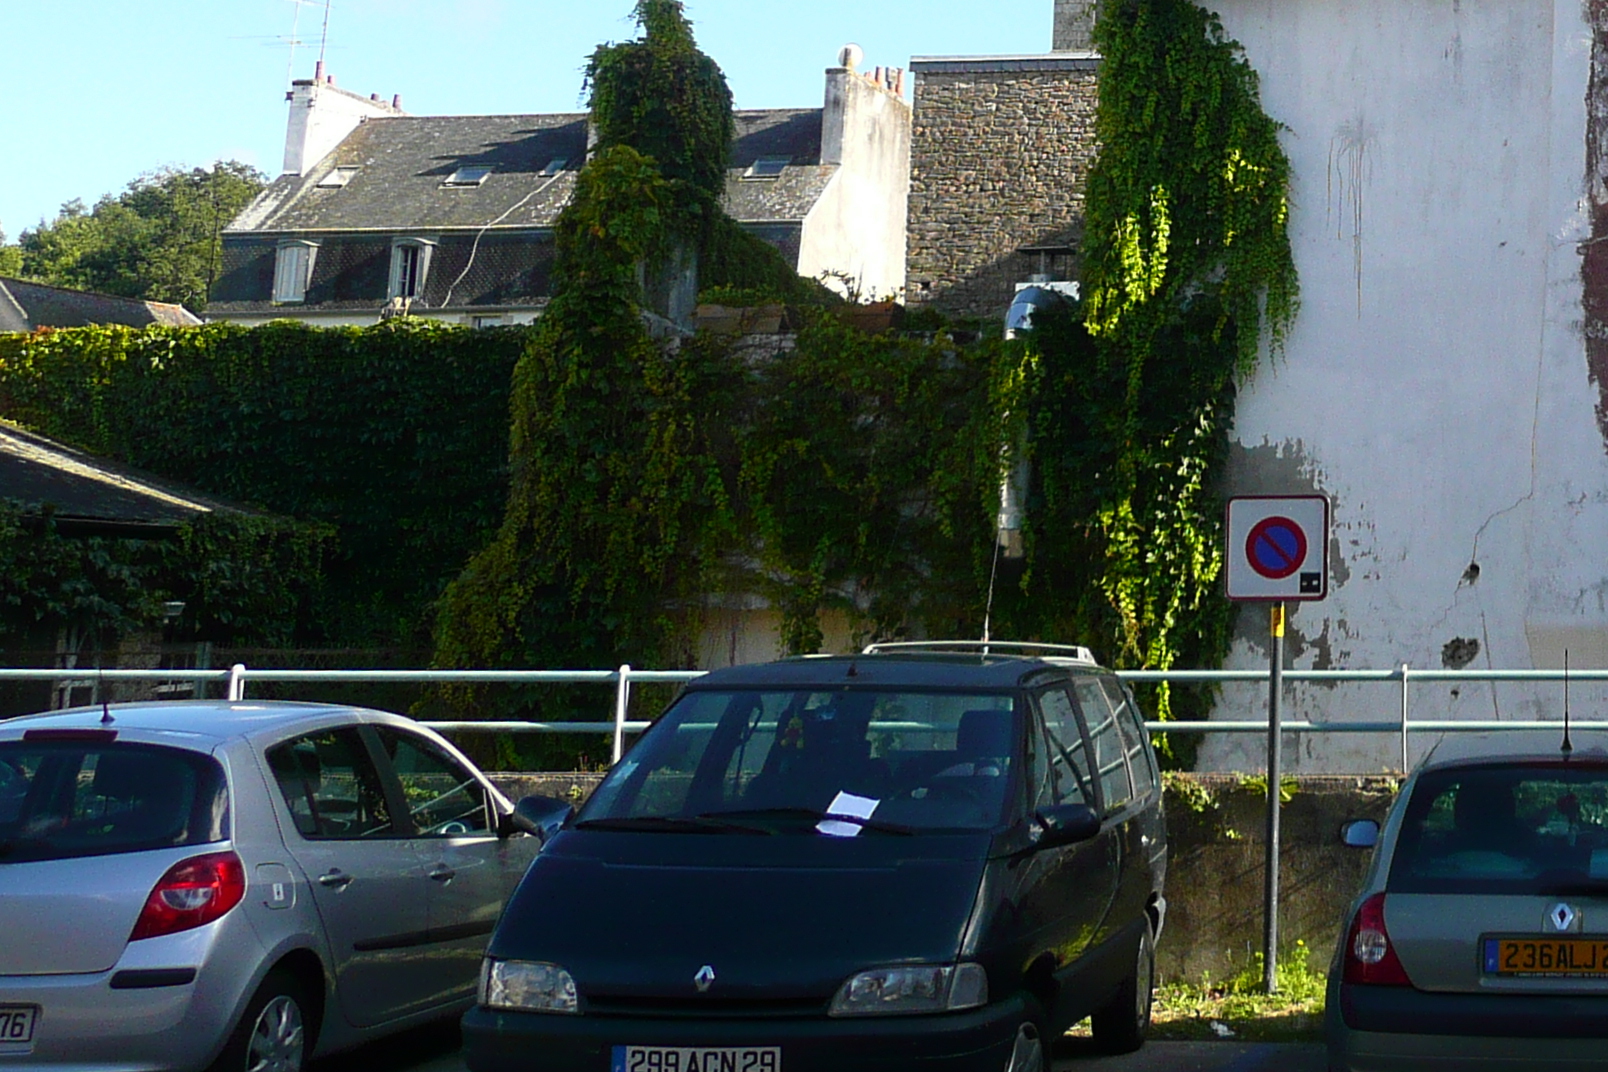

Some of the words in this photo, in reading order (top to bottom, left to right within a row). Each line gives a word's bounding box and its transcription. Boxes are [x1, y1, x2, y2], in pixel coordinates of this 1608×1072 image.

[0, 1013, 26, 1038] 76
[631, 1050, 680, 1072] 299
[686, 1051, 736, 1072] ACN
[742, 1050, 776, 1072] 29
